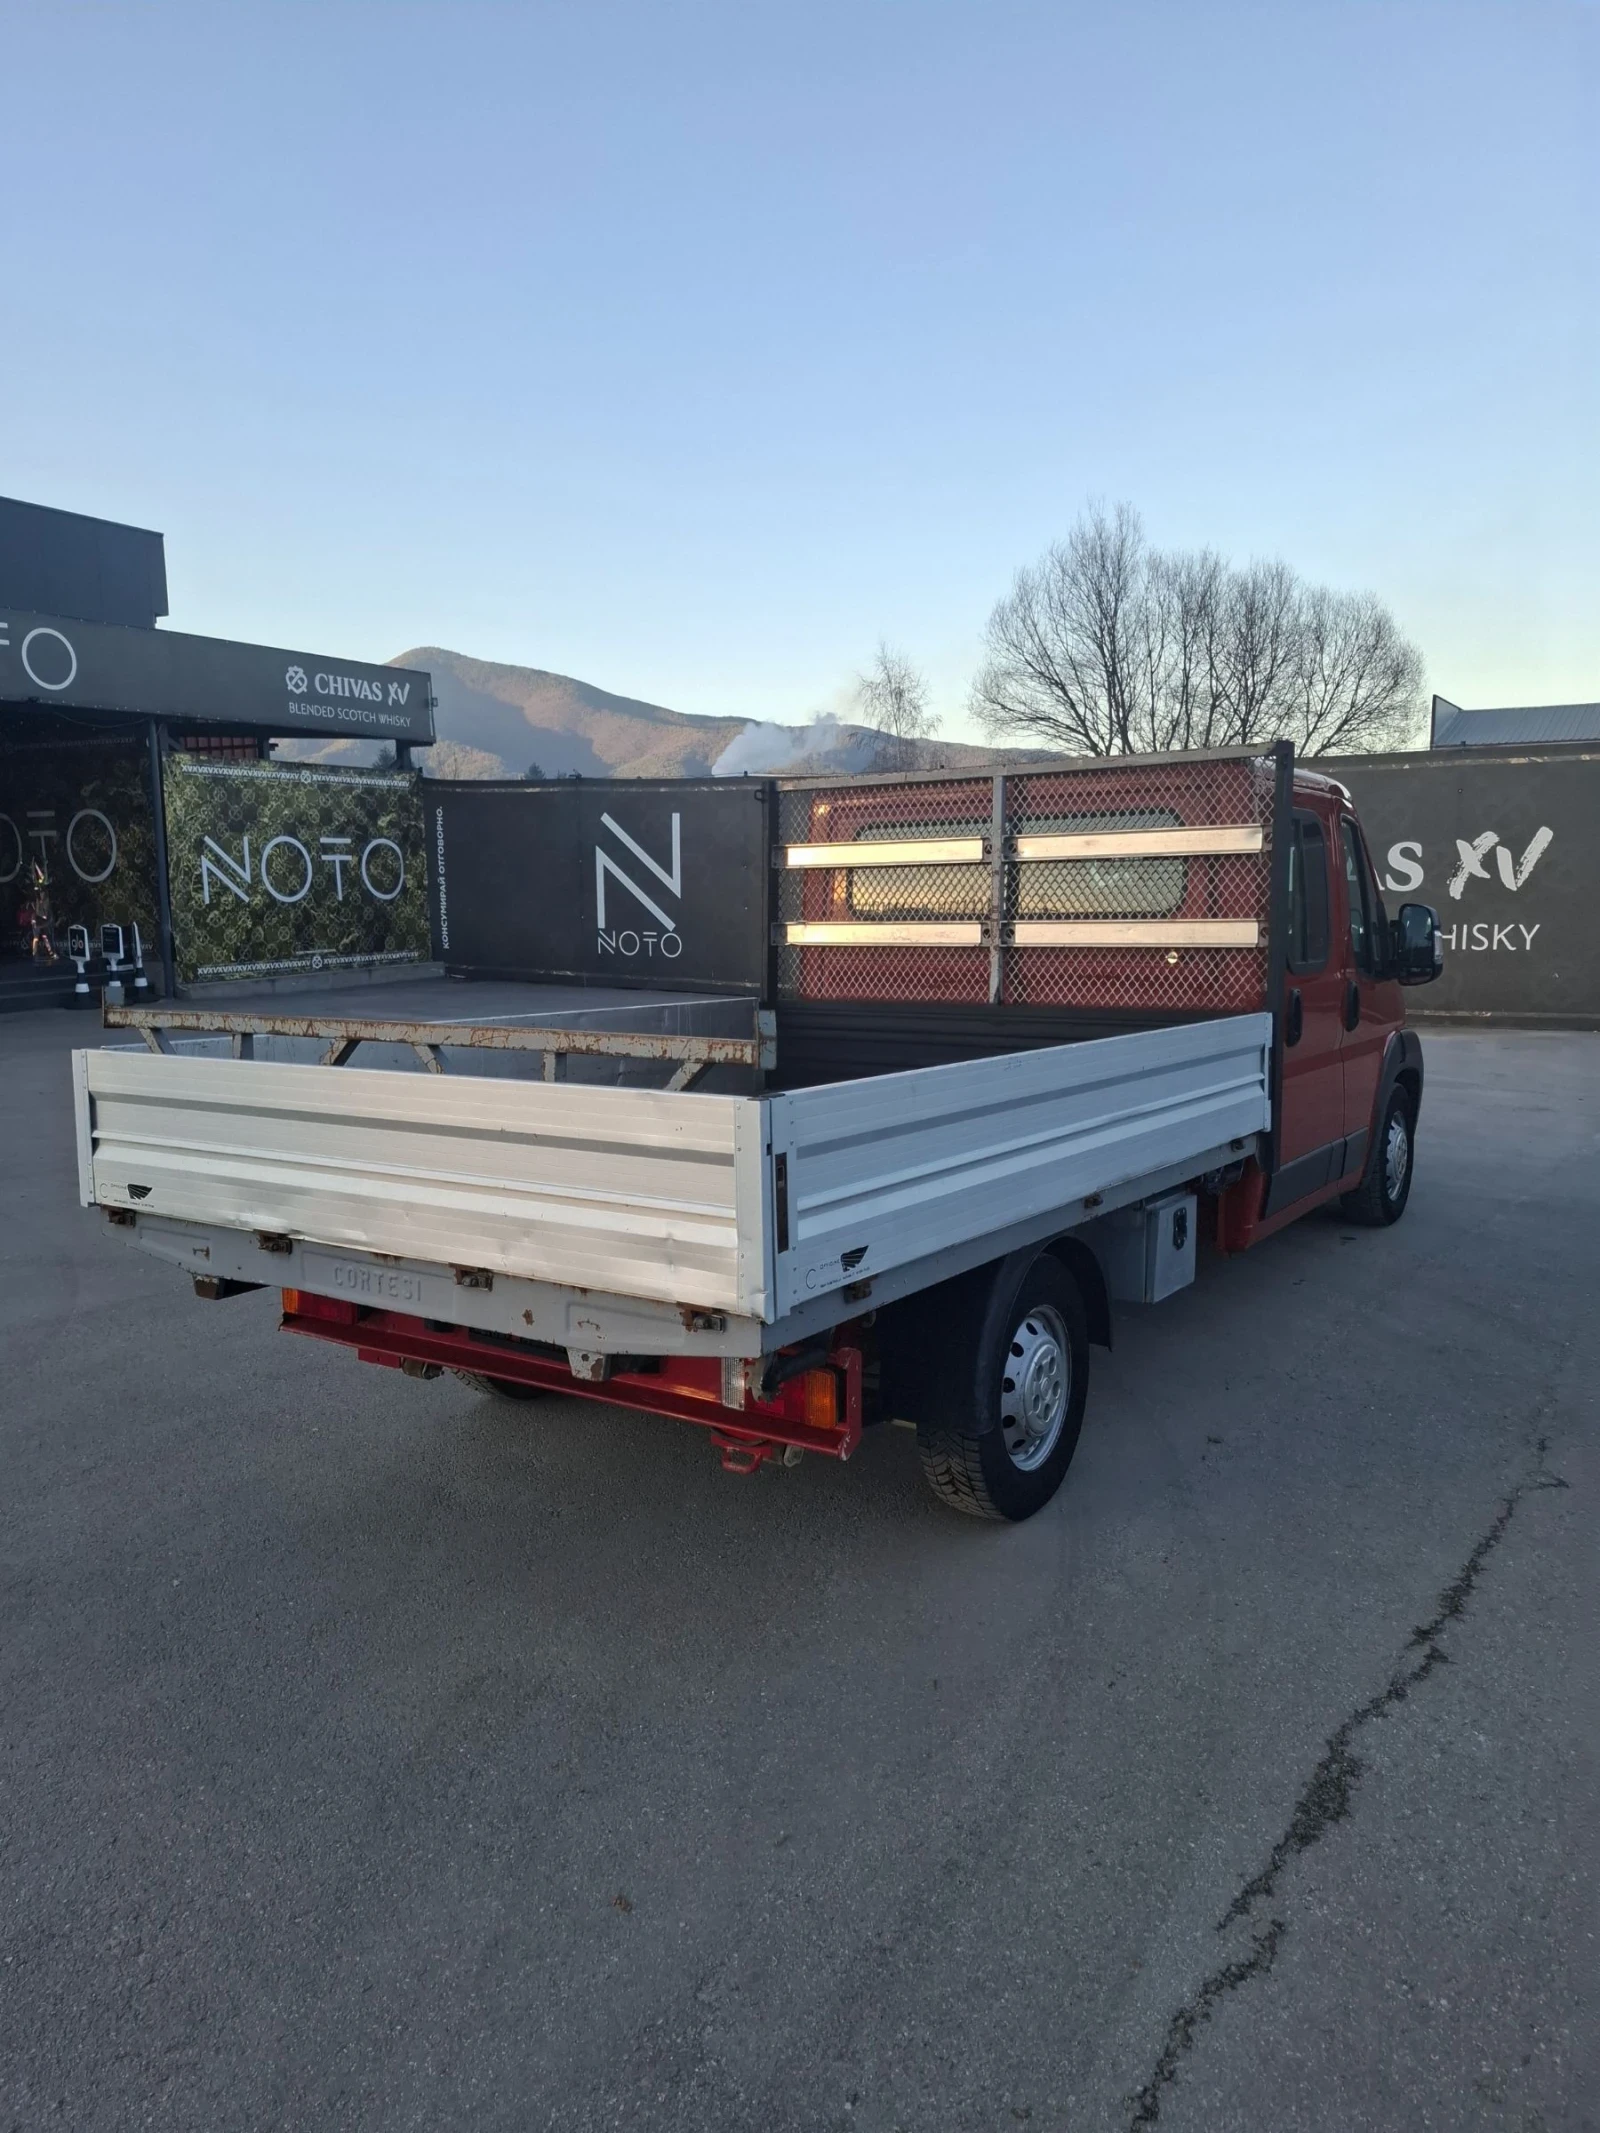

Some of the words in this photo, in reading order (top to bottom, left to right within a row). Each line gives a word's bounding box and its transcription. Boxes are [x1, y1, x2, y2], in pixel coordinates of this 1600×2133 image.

[0, 622, 77, 690] O
[288, 702, 335, 718] BLENDED
[337, 708, 377, 723] SCOTCH
[378, 713, 411, 727] WHISKY
[314, 673, 382, 702] CHIVAS
[387, 681, 410, 706] XV
[435, 806, 446, 875] ОТГОВОРНО.
[1374, 841, 1424, 892] S
[1446, 826, 1554, 900] XV
[201, 835, 404, 905] NOTO
[438, 876, 450, 949] КОНСУМИРАЙ
[1442, 923, 1541, 951] HISKY
[598, 930, 682, 958] NOTO
[333, 1264, 422, 1302] CORTESI
